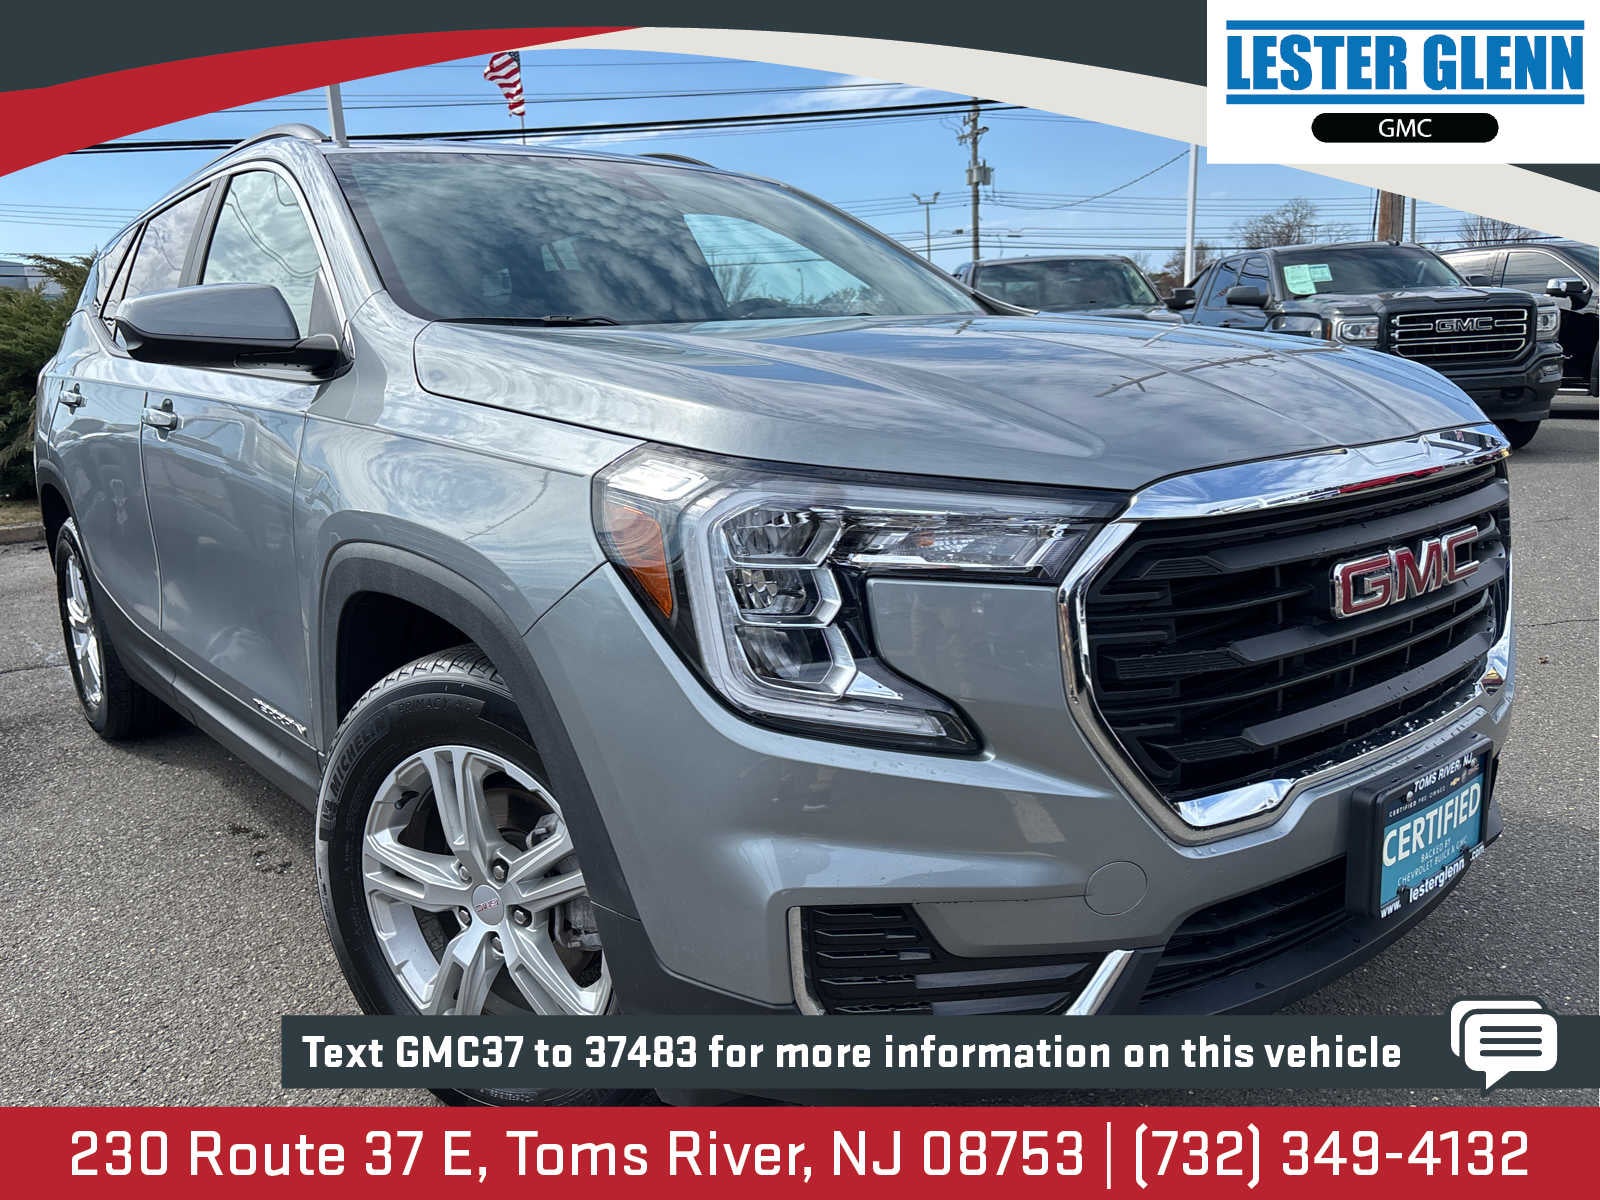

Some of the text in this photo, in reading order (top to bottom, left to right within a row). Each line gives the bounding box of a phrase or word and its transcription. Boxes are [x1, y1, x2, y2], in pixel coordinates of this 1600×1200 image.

[1436, 316, 1493, 333] GMC
[1333, 525, 1481, 619] GMC
[1414, 771, 1437, 793] TOMS
[1382, 782, 1481, 867] CERTIFIED
[1397, 857, 1433, 887] CHEVROLET
[1409, 858, 1465, 904] lesterglenn
